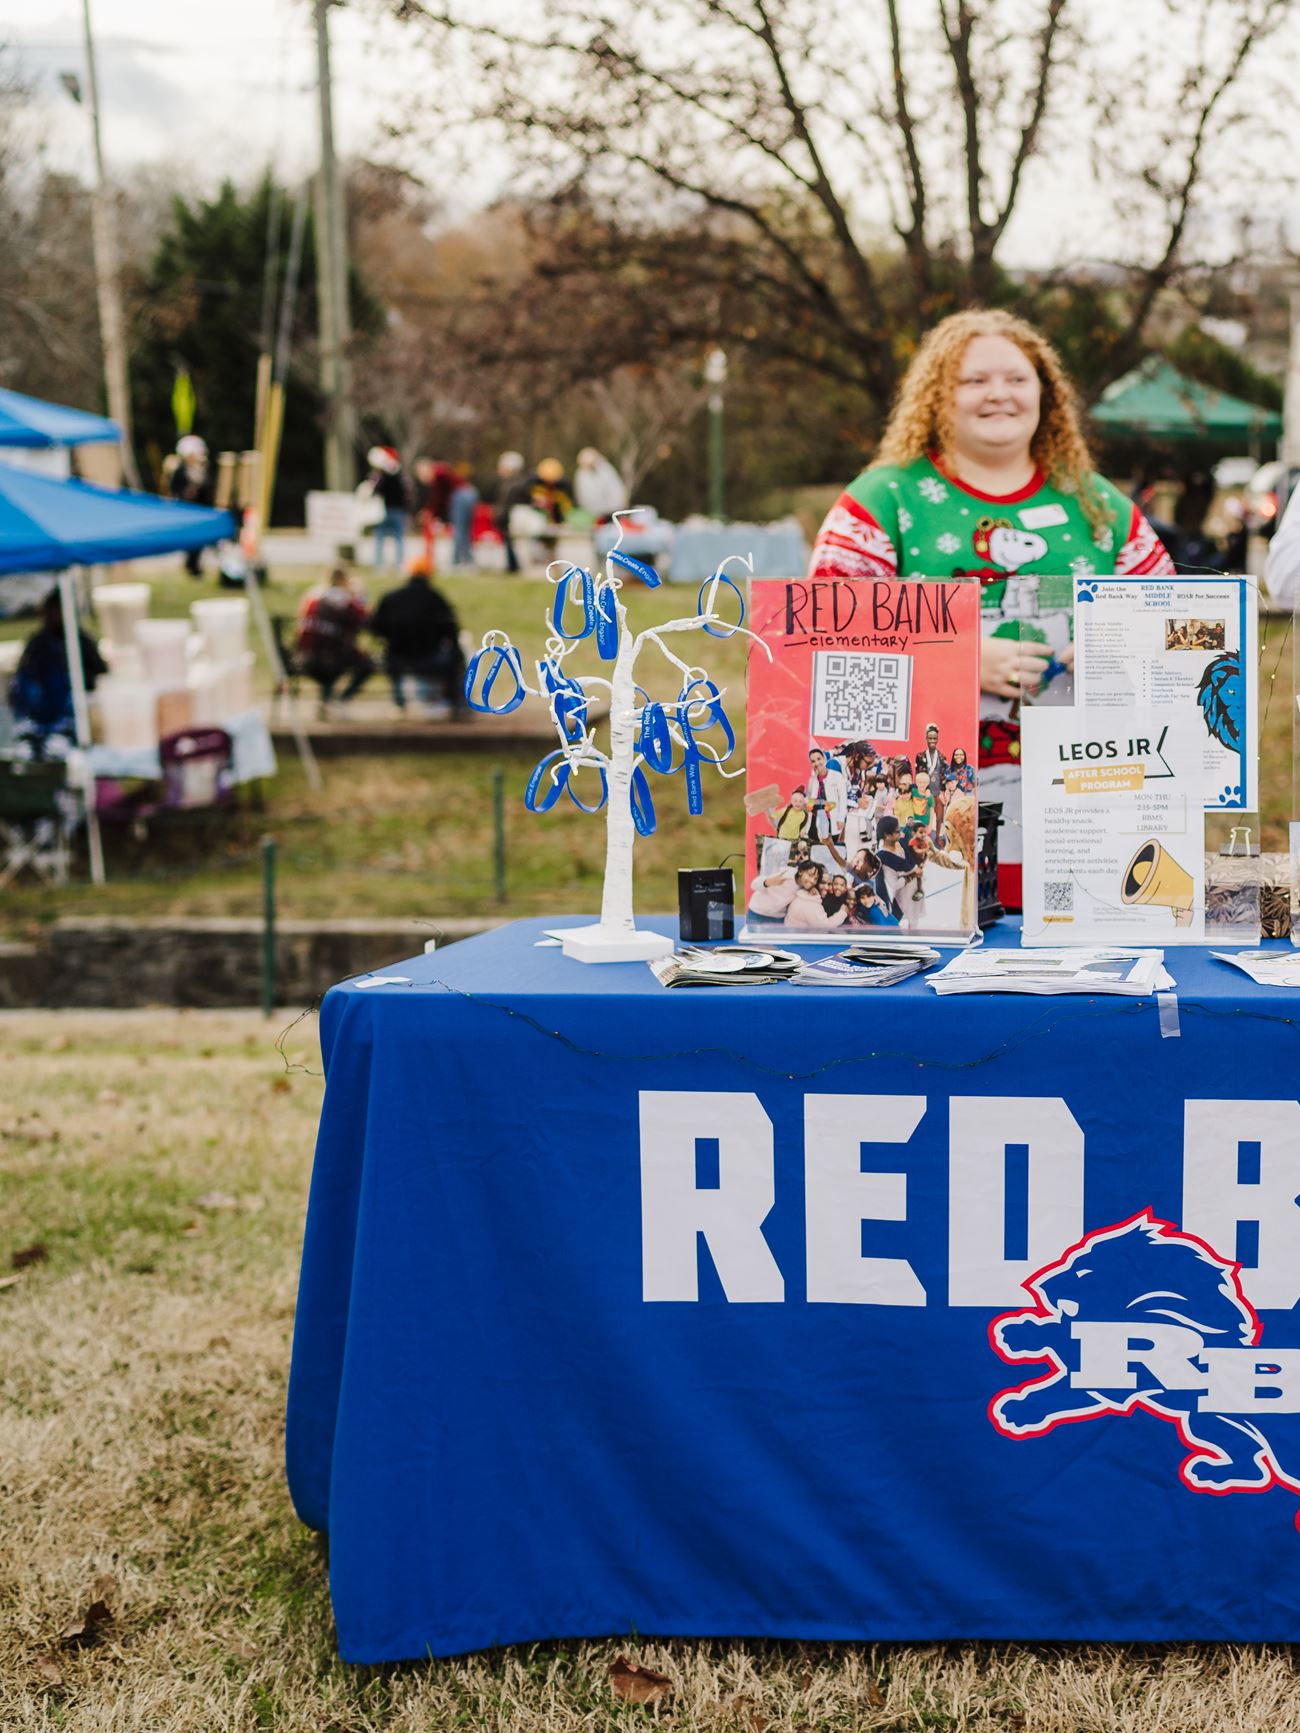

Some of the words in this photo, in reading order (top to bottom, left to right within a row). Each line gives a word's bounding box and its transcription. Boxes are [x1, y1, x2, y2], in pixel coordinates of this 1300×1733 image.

[1125, 593, 1138, 601] Way
[786, 582, 858, 635] RED
[872, 581, 961, 635] BANK
[1144, 600, 1173, 608] SCHOOL
[1059, 740, 1118, 761] LEOS
[1126, 738, 1151, 756] JR
[1068, 769, 1098, 779] AFTER
[1099, 766, 1142, 777] SCHOOL
[1080, 779, 1131, 791] PROGRAM
[1074, 807, 1104, 816] provides
[1044, 817, 1070, 826] healthy
[639, 1090, 1085, 1307] RED
